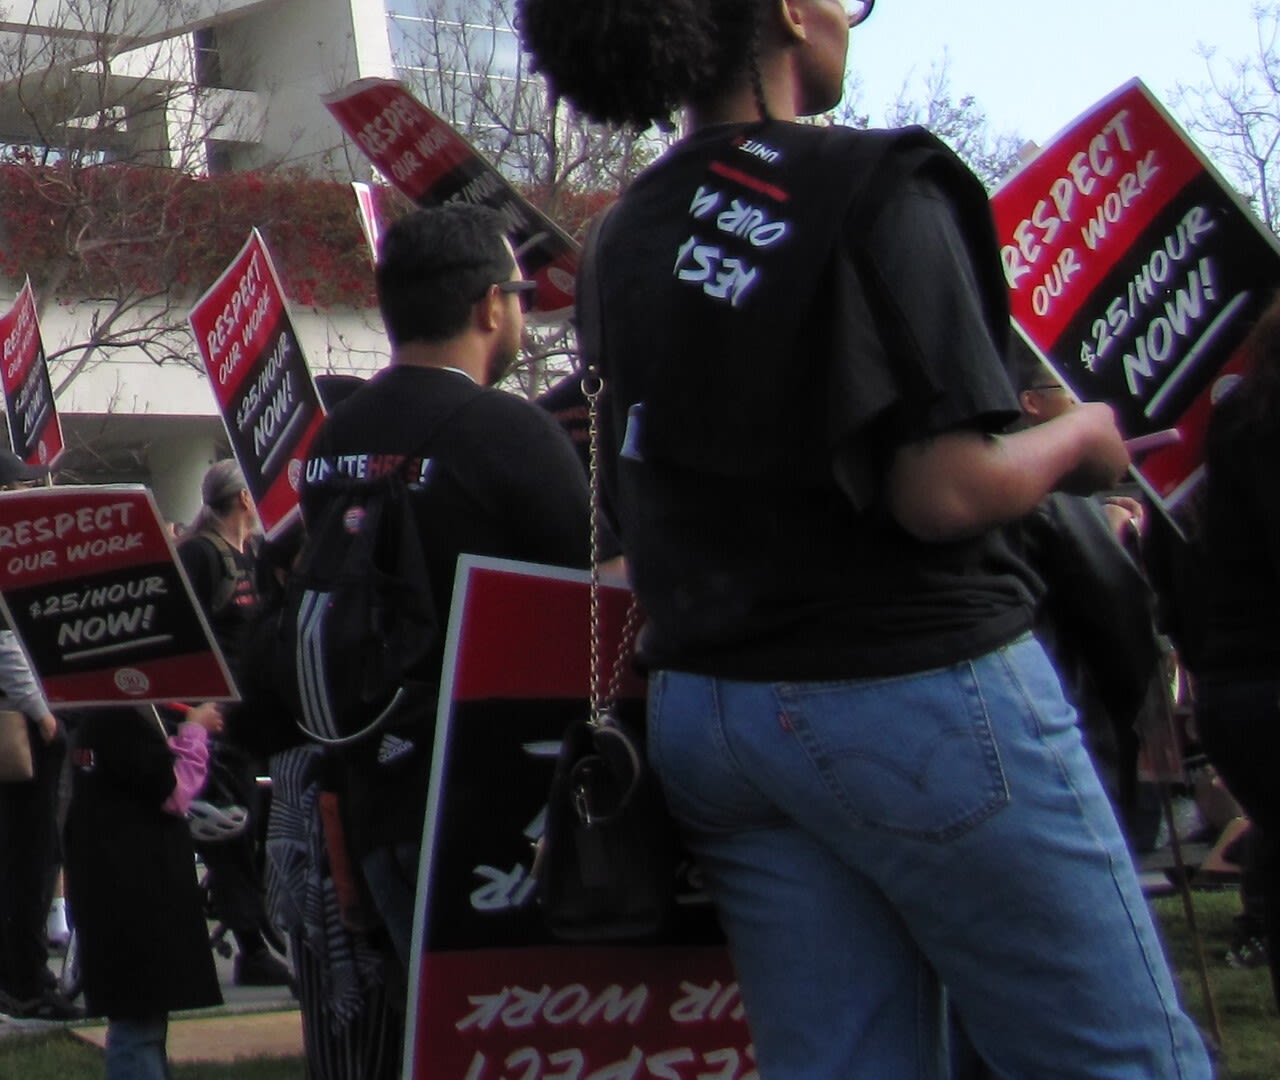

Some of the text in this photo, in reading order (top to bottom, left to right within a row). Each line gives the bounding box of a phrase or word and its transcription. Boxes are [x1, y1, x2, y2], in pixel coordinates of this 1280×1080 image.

[717, 199, 786, 247] OUR
[1000, 110, 1132, 289] RESPECT
[1032, 150, 1160, 317] OUR WORK
[206, 250, 262, 361] RESPECT
[219, 283, 271, 385] OUR WORK
[1080, 206, 1215, 372] $25/HOUR
[1122, 257, 1215, 396] NOW!
[253, 370, 292, 456] NOW!
[7, 531, 144, 575] OUR WORK
[29, 575, 168, 619] $25/HOUR
[57, 604, 155, 647] NOW!
[455, 983, 649, 1032] WORK
